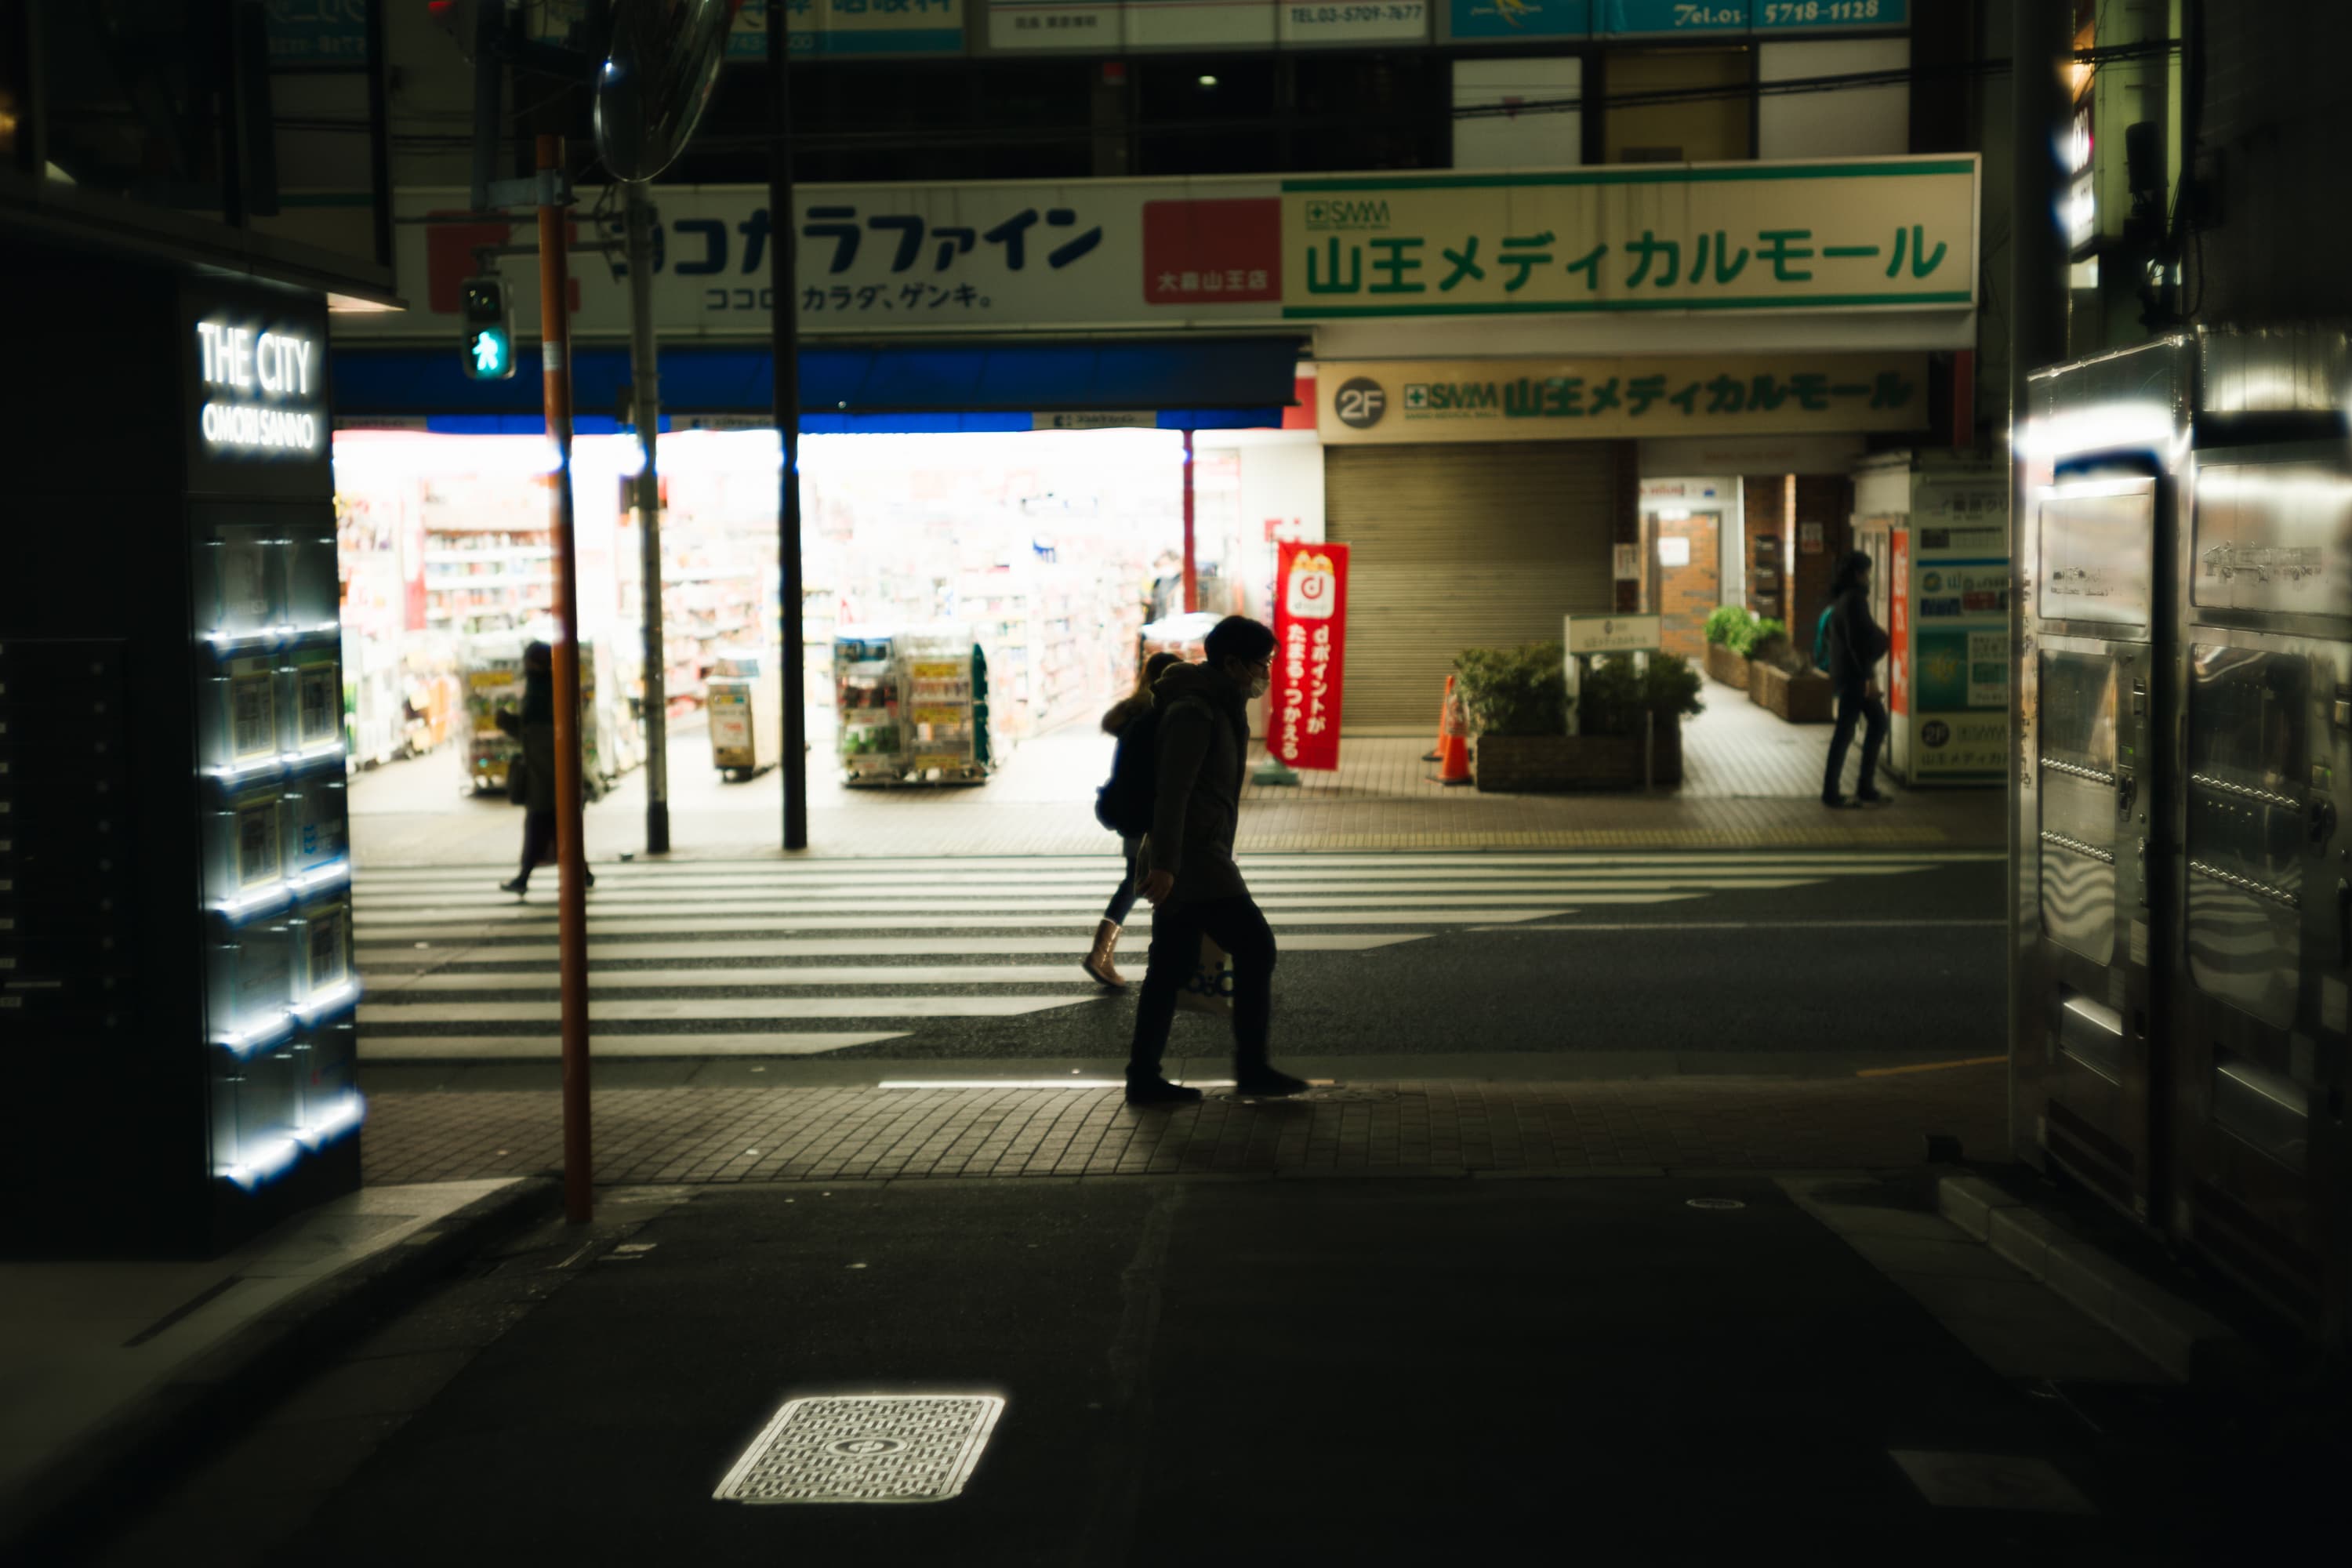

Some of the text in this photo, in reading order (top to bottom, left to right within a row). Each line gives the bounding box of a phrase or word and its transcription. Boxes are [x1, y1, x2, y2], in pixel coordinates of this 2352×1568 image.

[1307, 226, 1947, 295] 山王メディカルモール
[198, 322, 310, 394] THE CITY
[1340, 389, 1382, 419] 2F
[1504, 373, 1914, 417] 山王メディカルモール
[260, 408, 314, 449] SANNO
[1306, 624, 1331, 735] dポイントが
